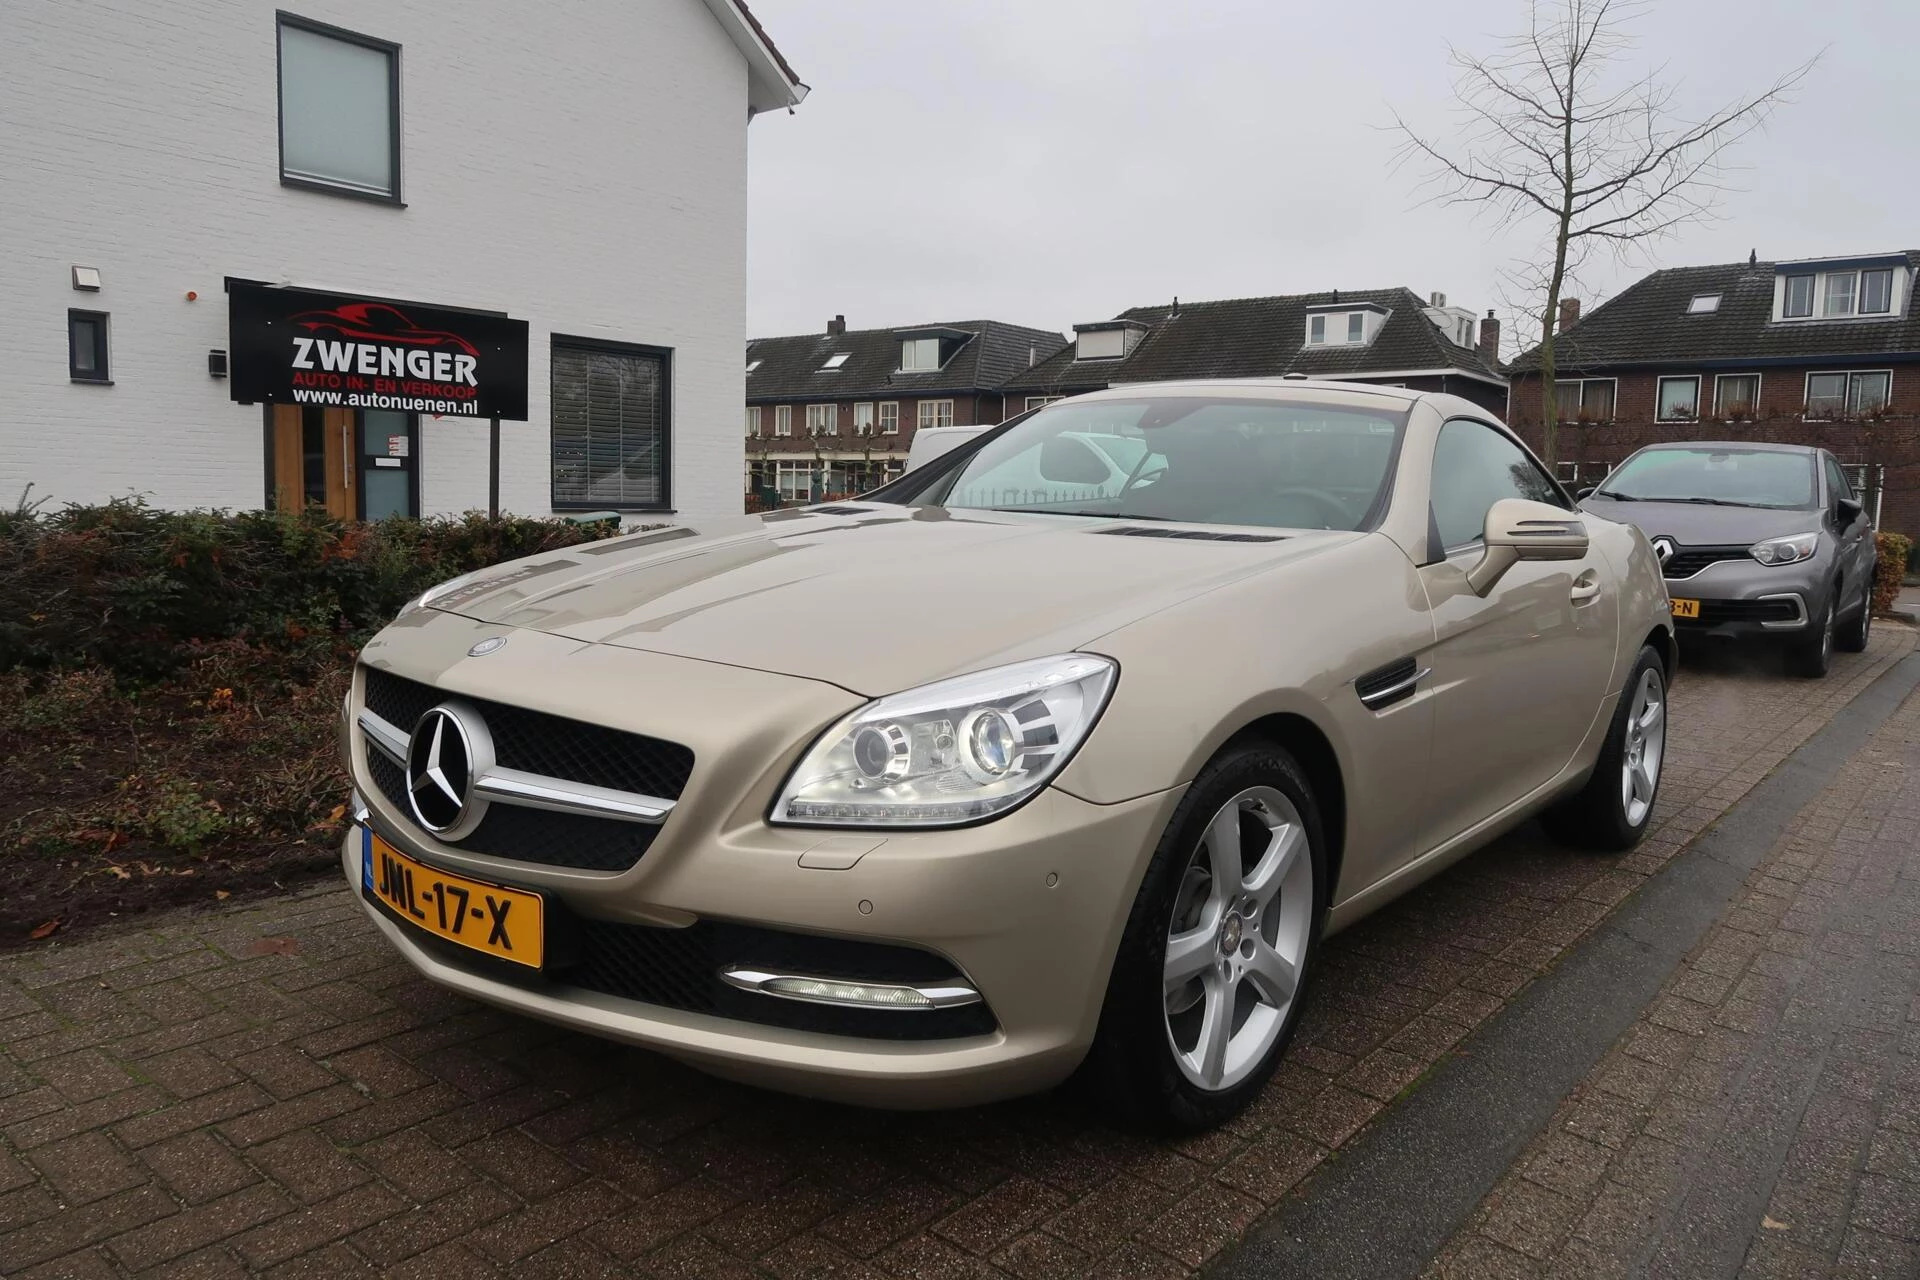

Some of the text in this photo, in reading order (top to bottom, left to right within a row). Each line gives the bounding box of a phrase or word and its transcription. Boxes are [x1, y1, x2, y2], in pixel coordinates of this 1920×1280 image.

[292, 337, 478, 387] ZWENGER
[292, 373, 477, 400] AUTO IN- EN VERKOOP
[293, 388, 478, 415] www.autonuenen.nl
[380, 853, 512, 950] JNL-17-X
